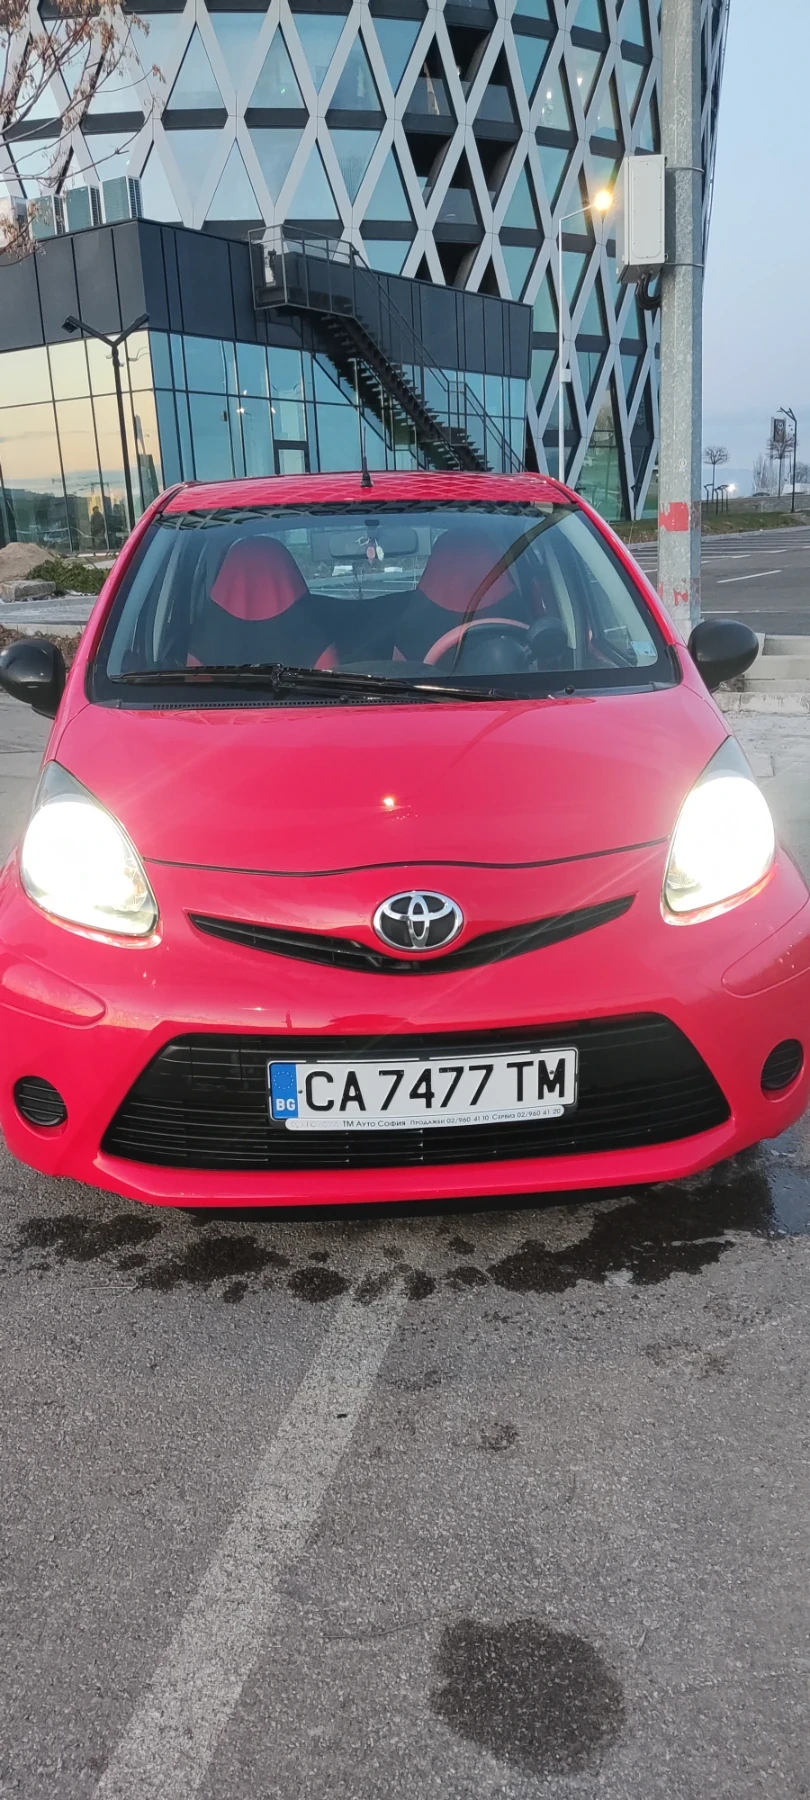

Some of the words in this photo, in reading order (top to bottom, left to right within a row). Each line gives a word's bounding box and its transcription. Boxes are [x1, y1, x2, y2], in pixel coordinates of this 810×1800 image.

[305, 1070, 366, 1111] CA
[378, 1064, 494, 1111] 7477
[507, 1058, 566, 1102] TM
[275, 1098, 296, 1111] BG
[446, 1116, 471, 1124] 02/960
[517, 1110, 541, 1118] 02/960
[552, 1107, 561, 1115] 20
